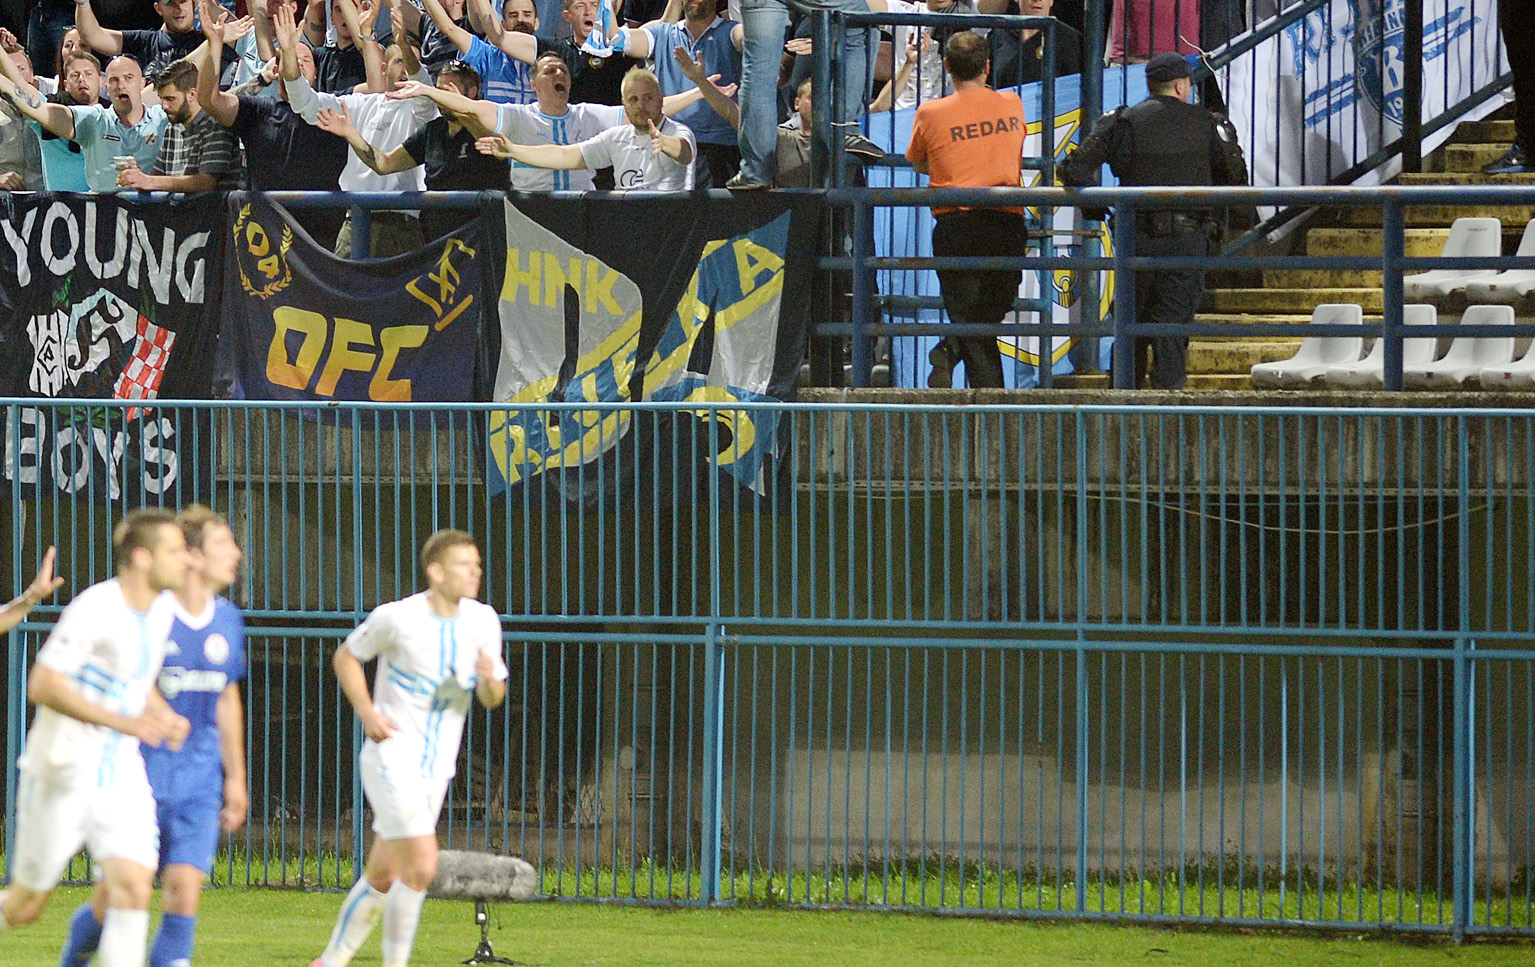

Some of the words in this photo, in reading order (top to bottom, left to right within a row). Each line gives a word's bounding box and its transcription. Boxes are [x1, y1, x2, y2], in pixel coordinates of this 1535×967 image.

[950, 116, 1020, 143] REDAR
[0, 201, 211, 304] YOUNG
[500, 248, 623, 315] HNK
[266, 305, 429, 402] OFC
[5, 405, 178, 500] BOYS
